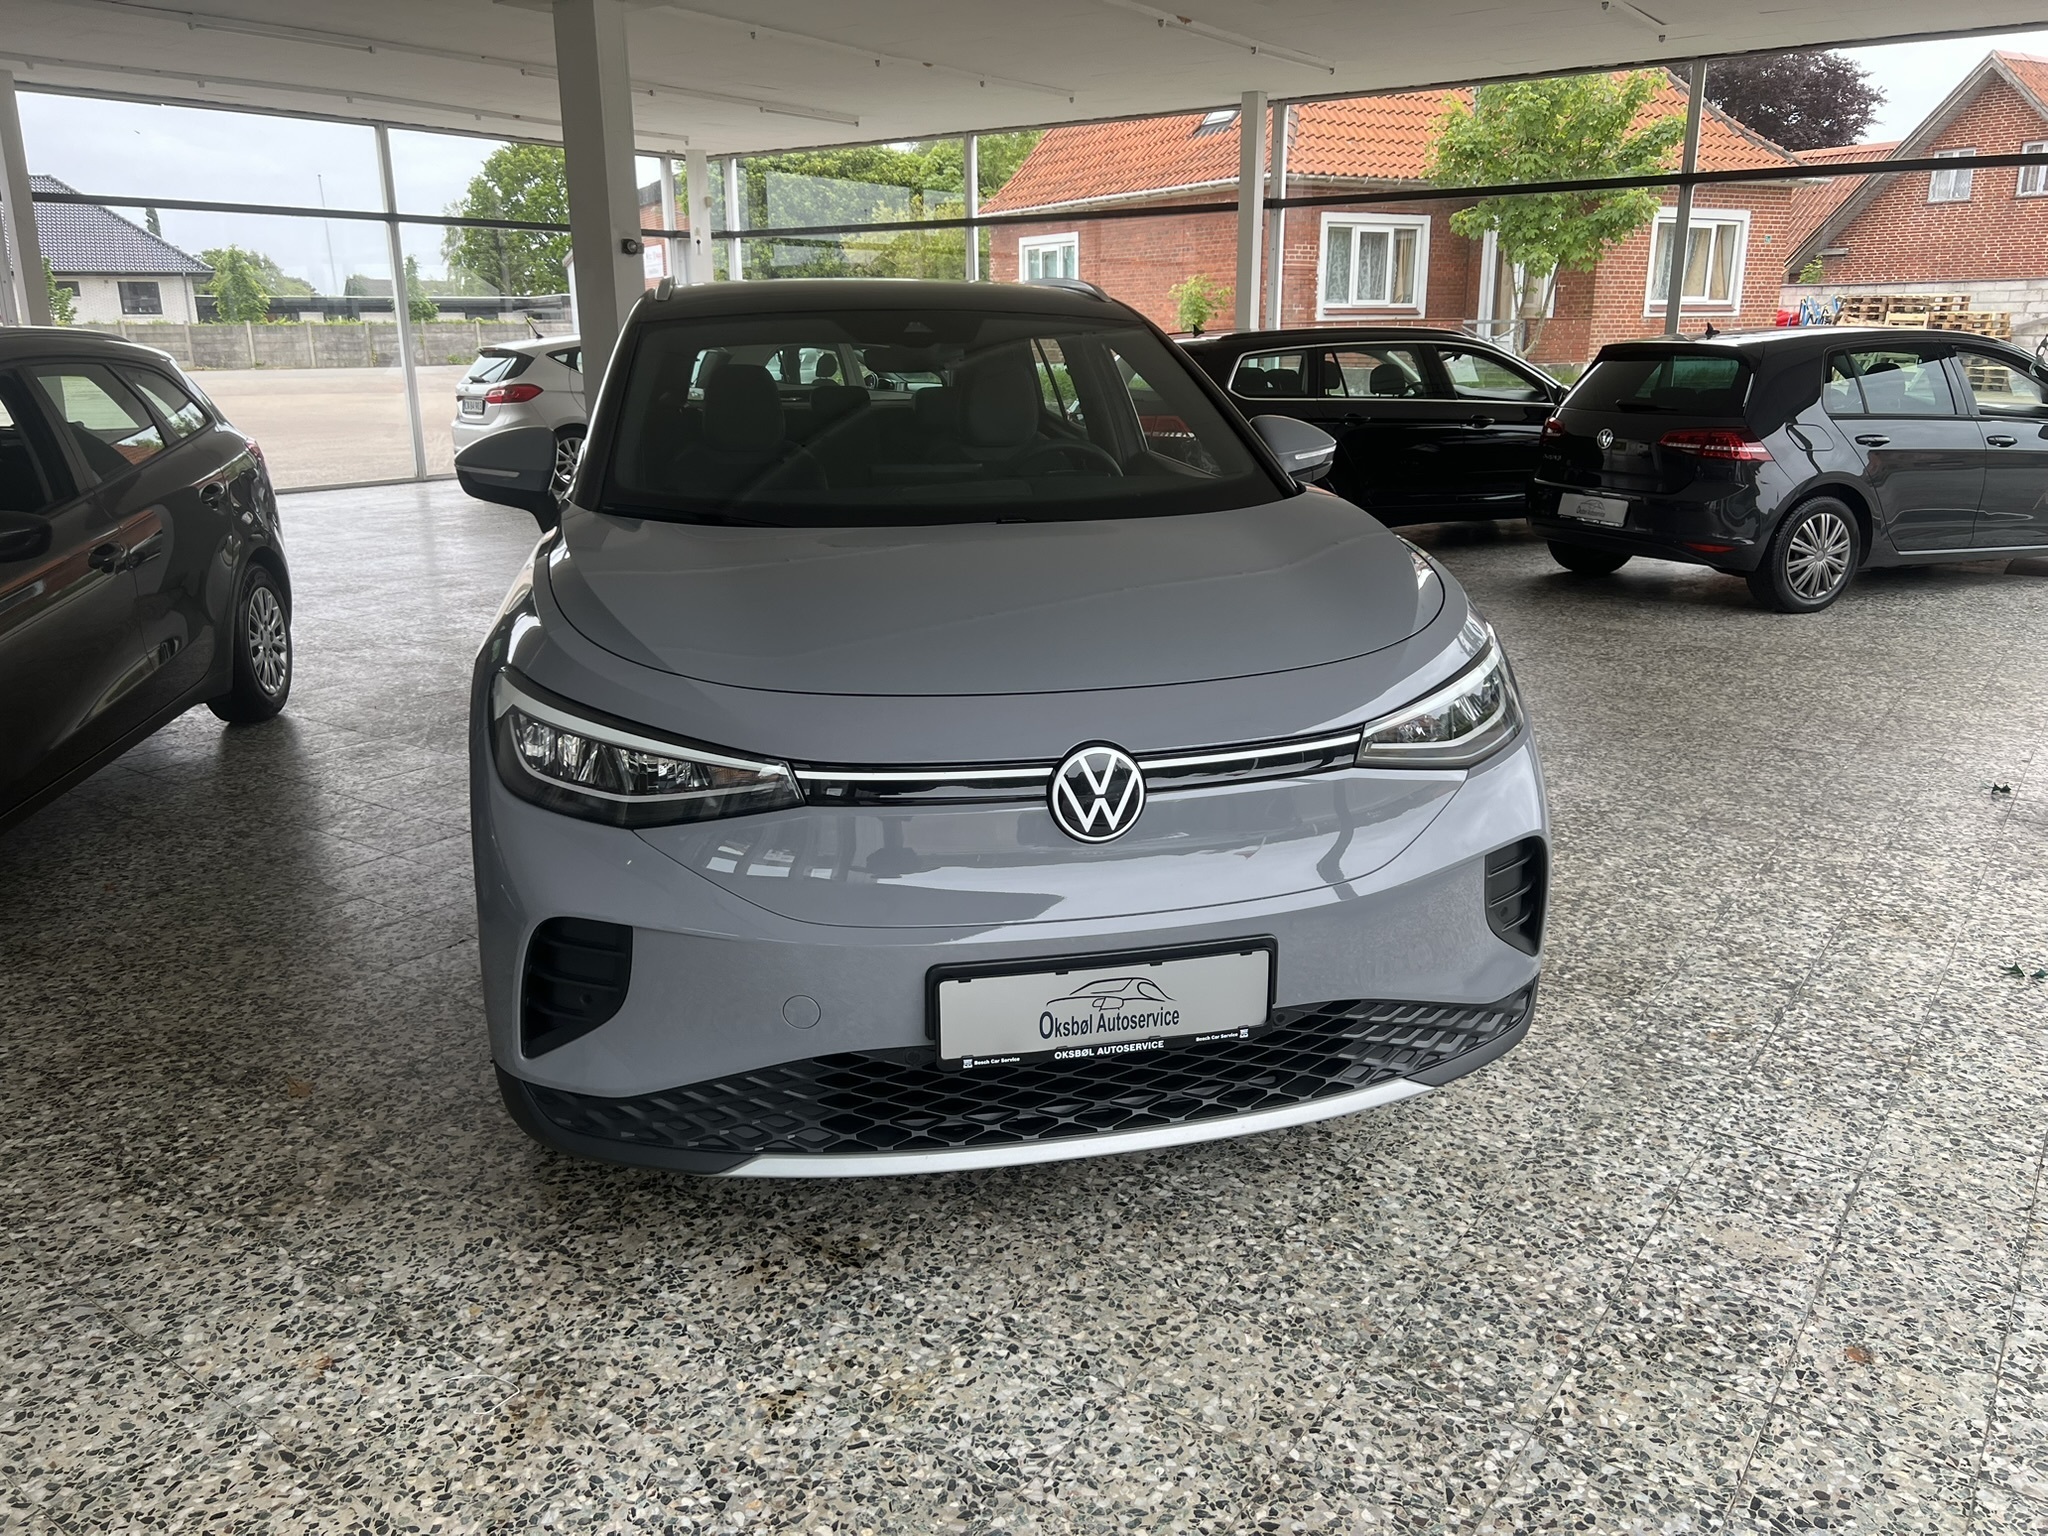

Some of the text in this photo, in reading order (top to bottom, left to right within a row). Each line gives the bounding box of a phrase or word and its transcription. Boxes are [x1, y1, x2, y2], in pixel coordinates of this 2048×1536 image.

[1040, 1006, 1180, 1039] Oksbøl Autoservice
[1054, 1040, 1165, 1060] OKSBØL AUTOSERVICE
